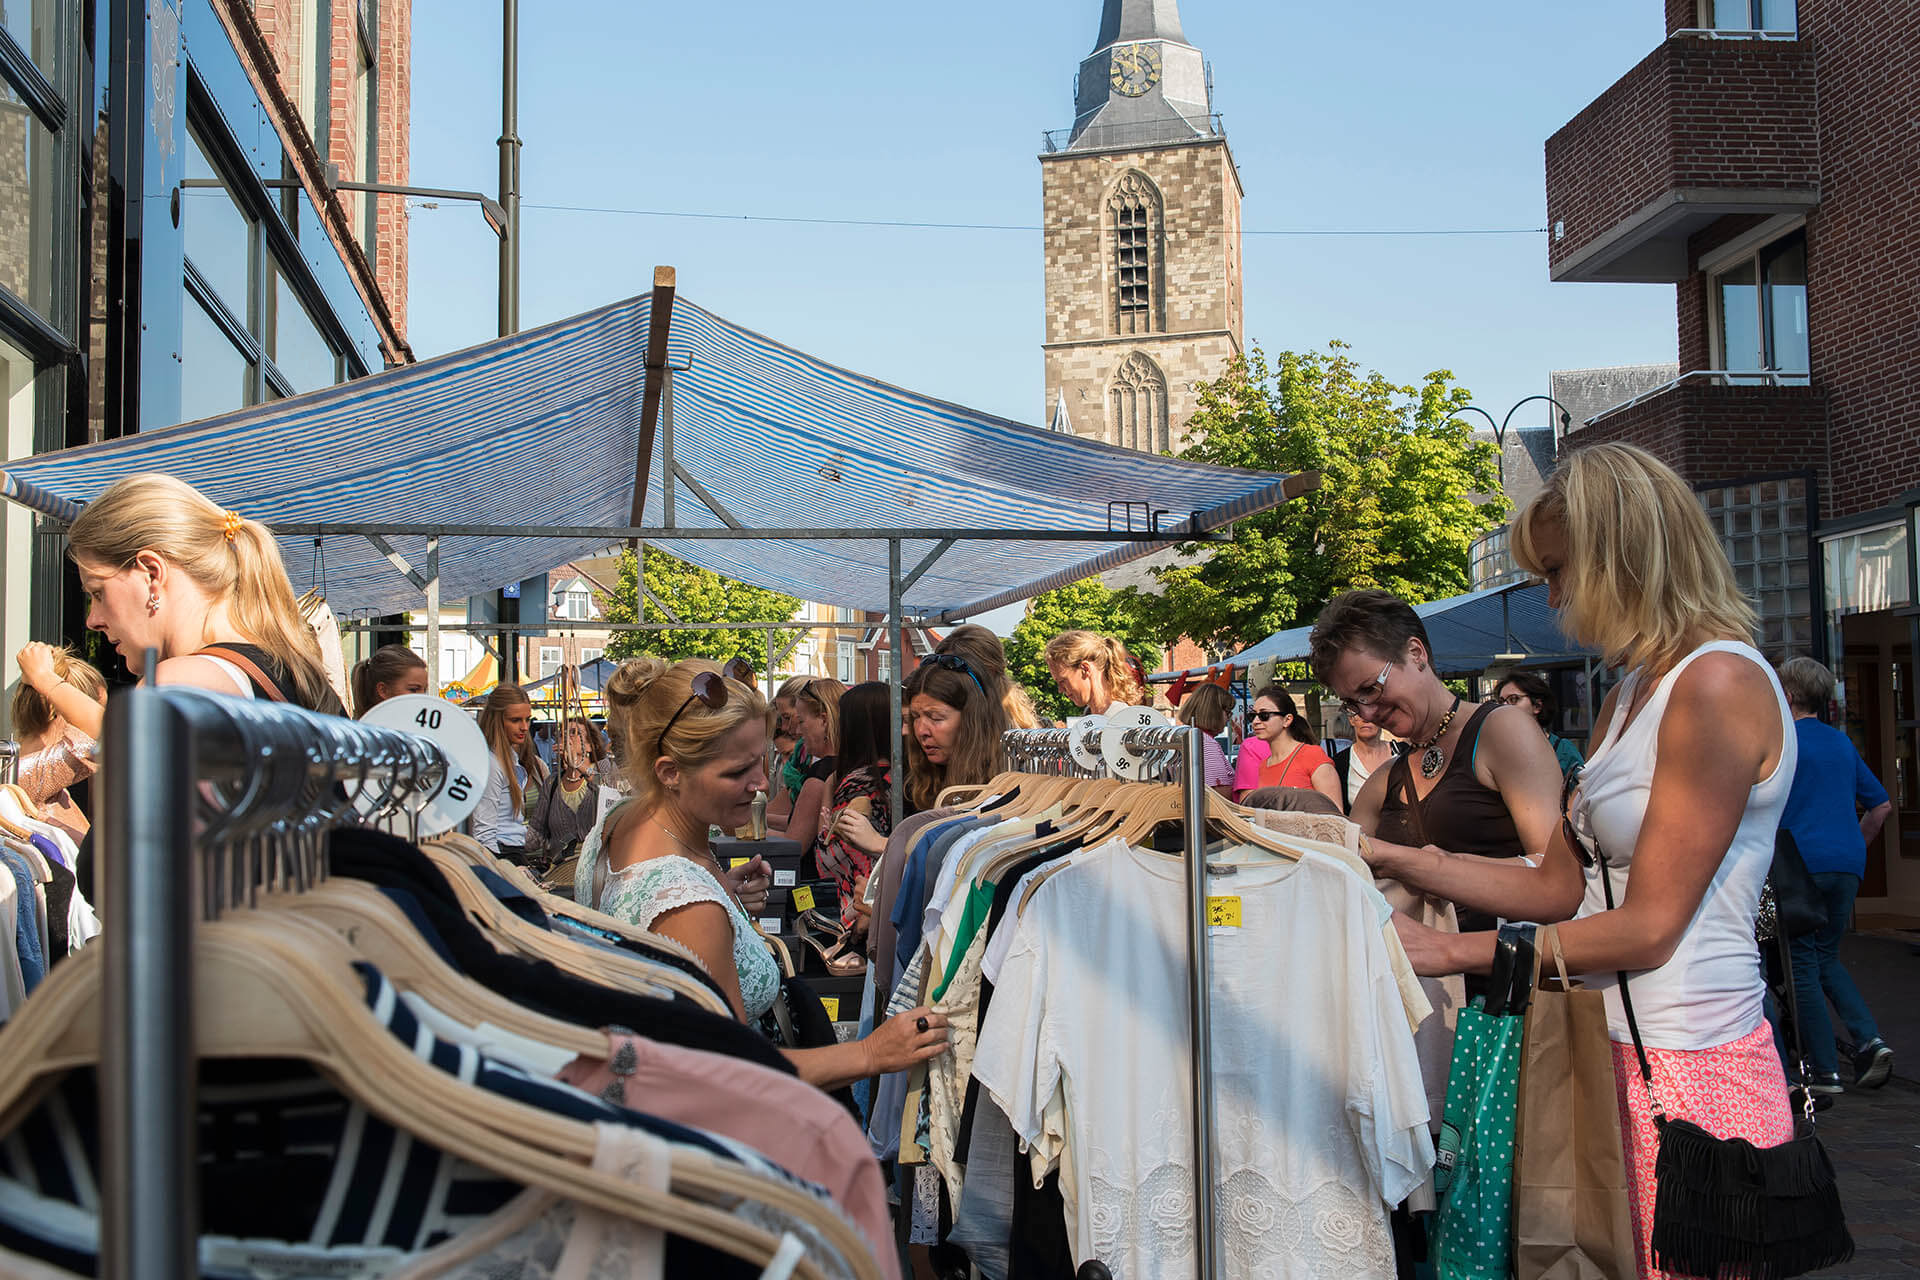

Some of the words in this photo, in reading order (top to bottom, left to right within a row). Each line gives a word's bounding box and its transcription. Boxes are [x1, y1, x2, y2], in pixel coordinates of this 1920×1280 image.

[416, 708, 441, 729] 40
[1083, 719, 1094, 729] 38
[1138, 714, 1151, 725] 36
[1116, 757, 1130, 770] 36
[448, 775, 472, 801] 40
